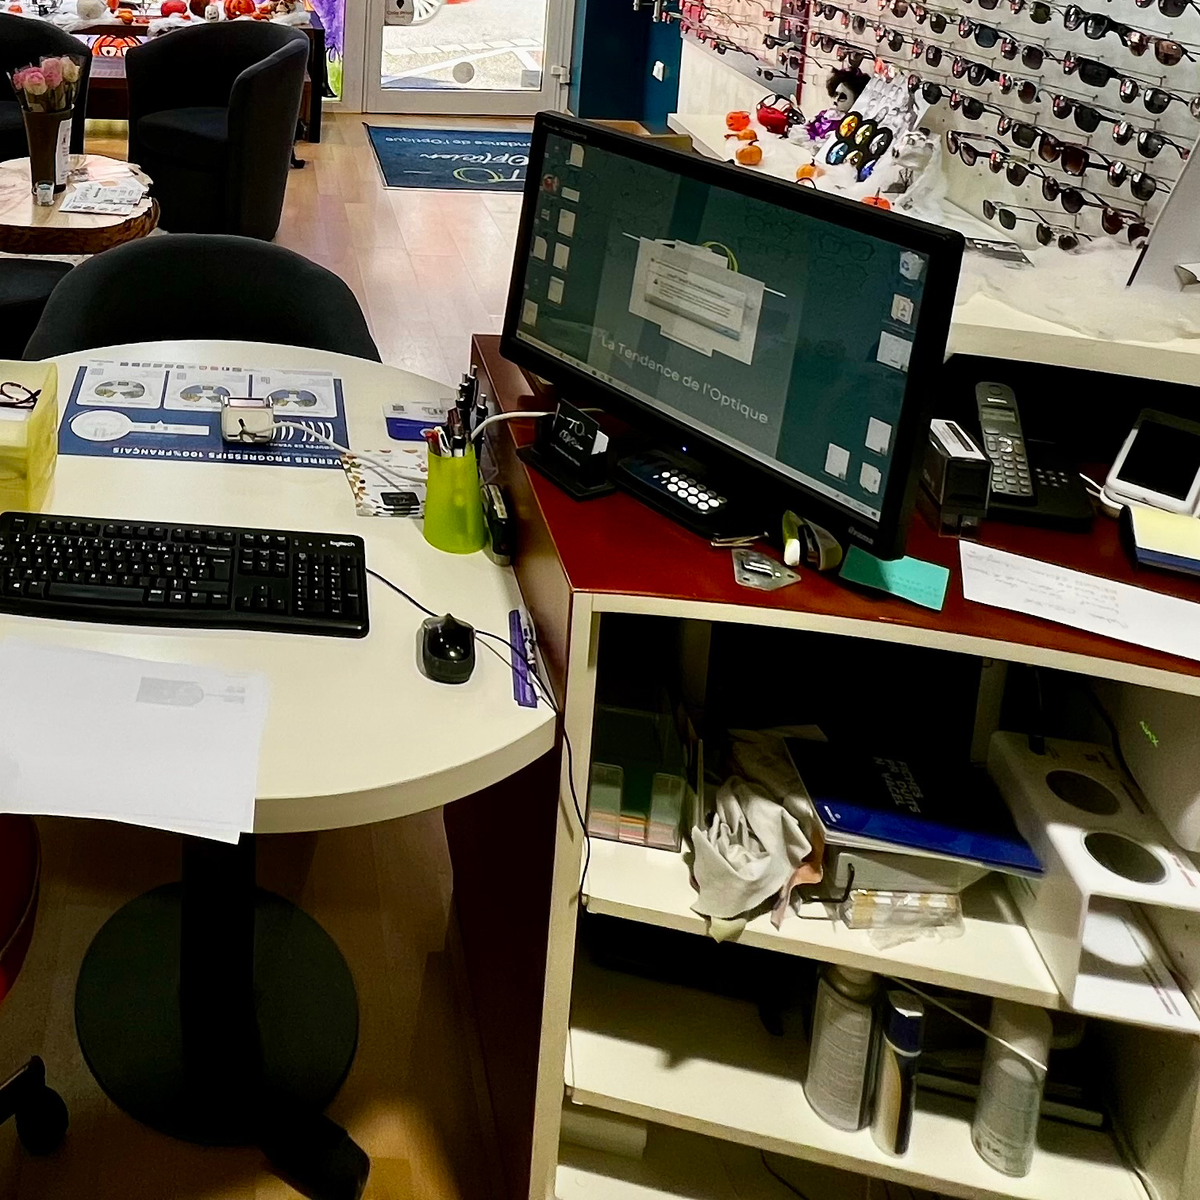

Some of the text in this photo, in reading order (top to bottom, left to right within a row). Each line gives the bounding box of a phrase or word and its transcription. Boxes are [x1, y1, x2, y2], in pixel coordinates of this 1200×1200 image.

[601, 337, 769, 425] La Tendance de l'Optique
[208, 452, 291, 463] PROGRESSIFS
[329, 540, 356, 548] logitech
